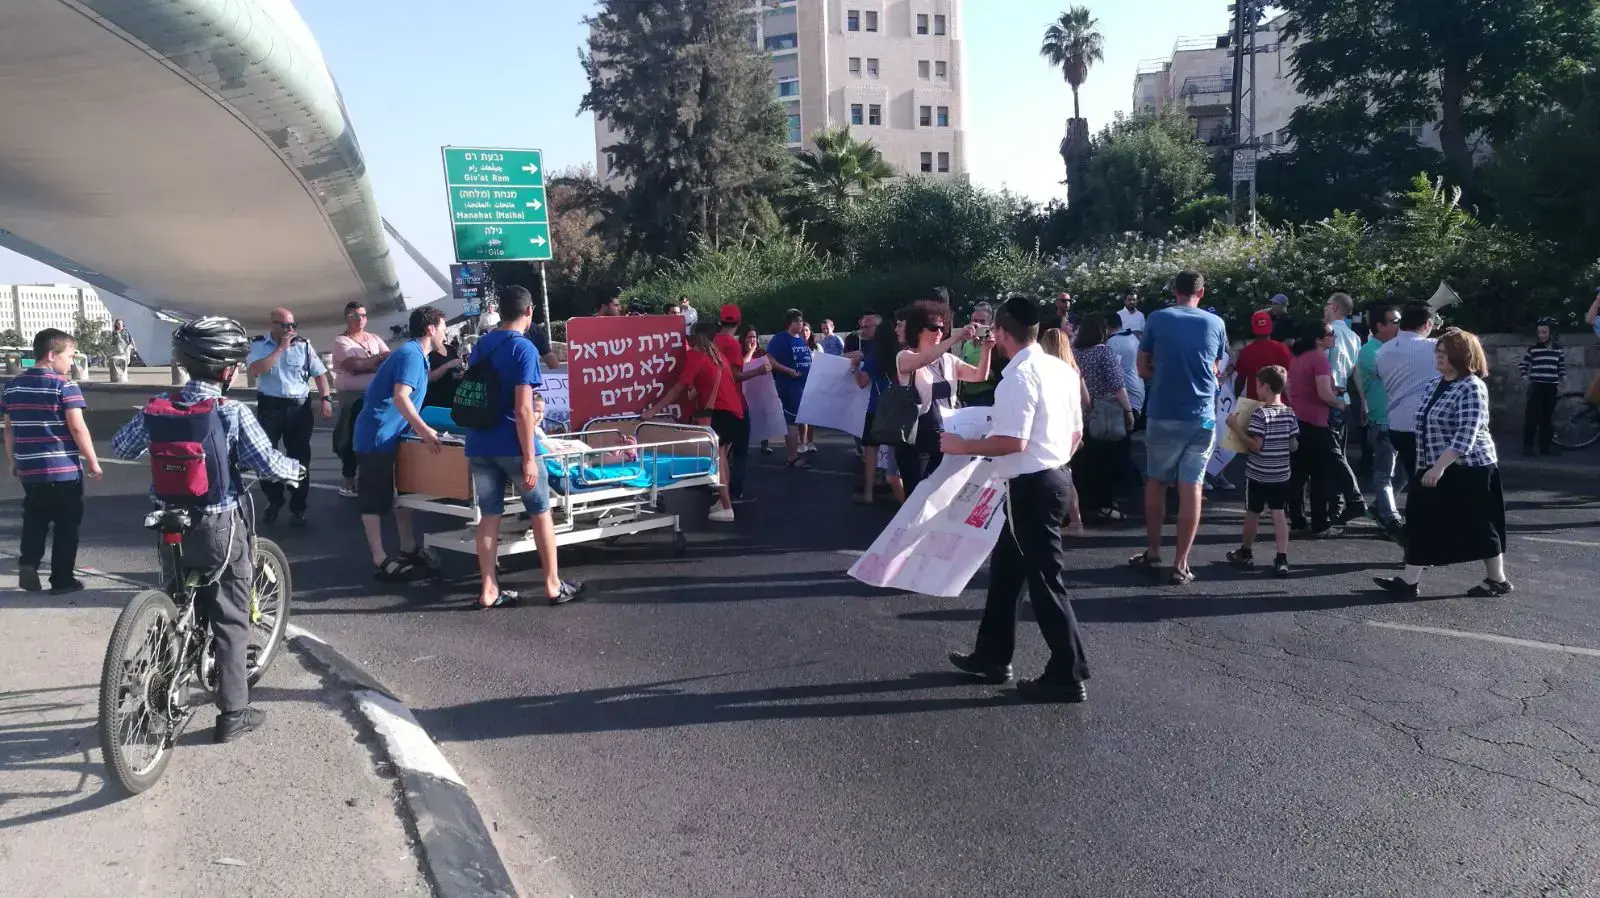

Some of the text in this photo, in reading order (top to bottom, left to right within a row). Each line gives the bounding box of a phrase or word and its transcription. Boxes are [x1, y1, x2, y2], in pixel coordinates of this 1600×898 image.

[464, 153, 503, 162] גבעת רם
[460, 189, 517, 199] מנחת (מלחה)
[456, 211, 525, 220] Manahat (Malha)
[484, 225, 503, 235] גילה
[488, 248, 505, 256] Gilo
[569, 331, 683, 361] בירת ישראל
[582, 352, 677, 385] ללא מענה
[600, 378, 665, 407] לילדים
